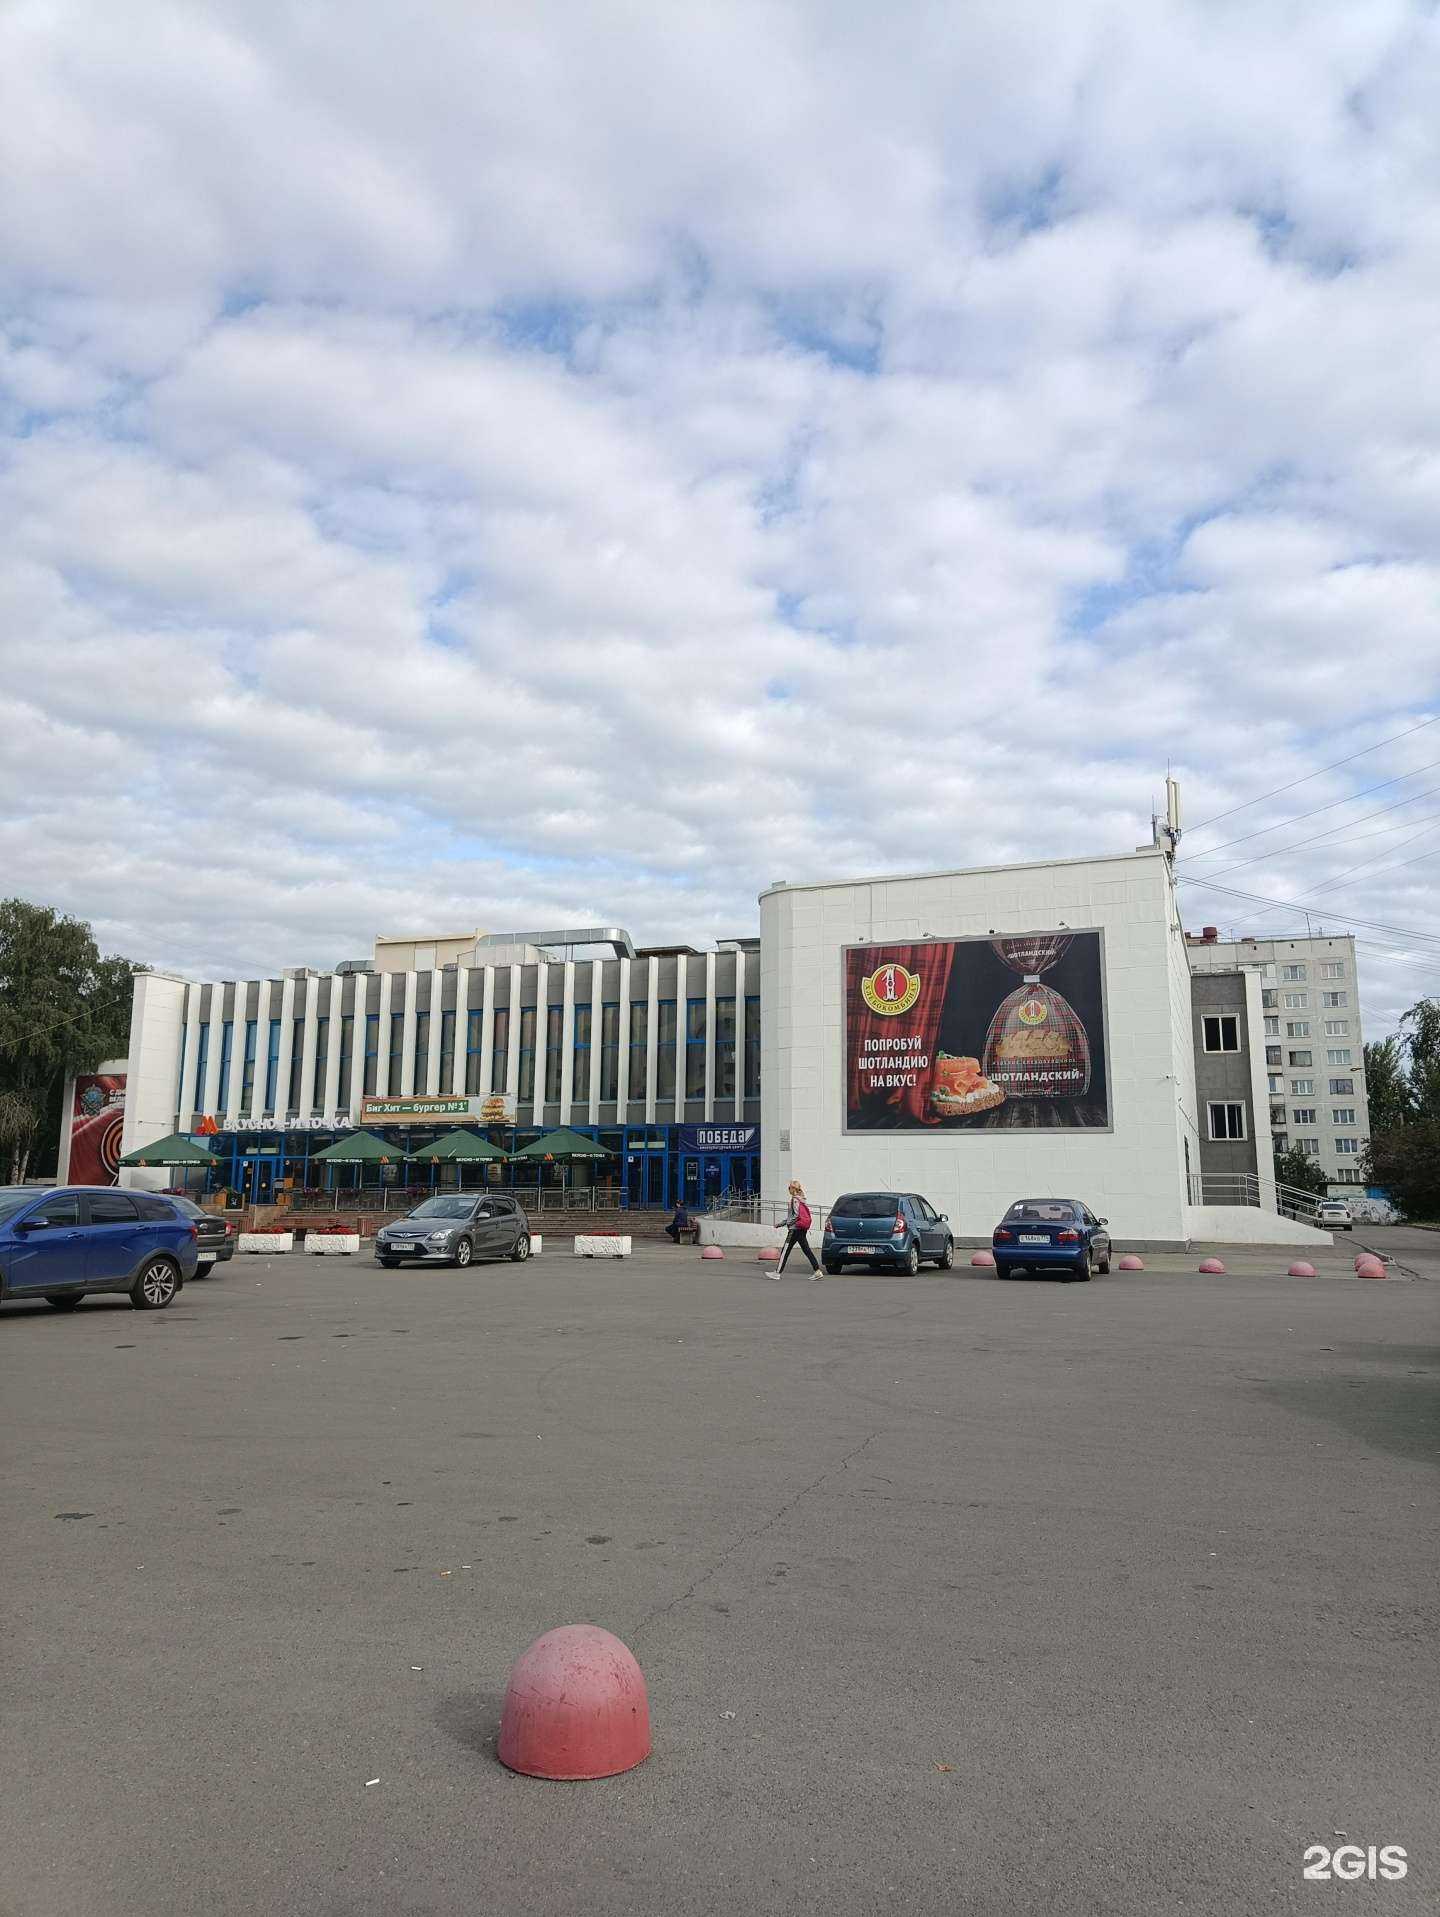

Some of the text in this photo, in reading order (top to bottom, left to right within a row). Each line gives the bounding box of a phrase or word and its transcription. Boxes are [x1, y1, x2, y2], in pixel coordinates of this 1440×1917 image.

[864, 982, 918, 1012] ХЛЕБОКОМБИНАТ
[864, 1035, 922, 1052] ПОПРОБУЙ
[858, 1055, 929, 1070] ШОТЛАНДИЮ
[870, 1074, 917, 1087] НА ВКУС!
[366, 1103, 381, 1113] Биг
[383, 1103, 400, 1112] Хит
[413, 1102, 446, 1113] бургер
[699, 1130, 745, 1144] ПОБЕДА
